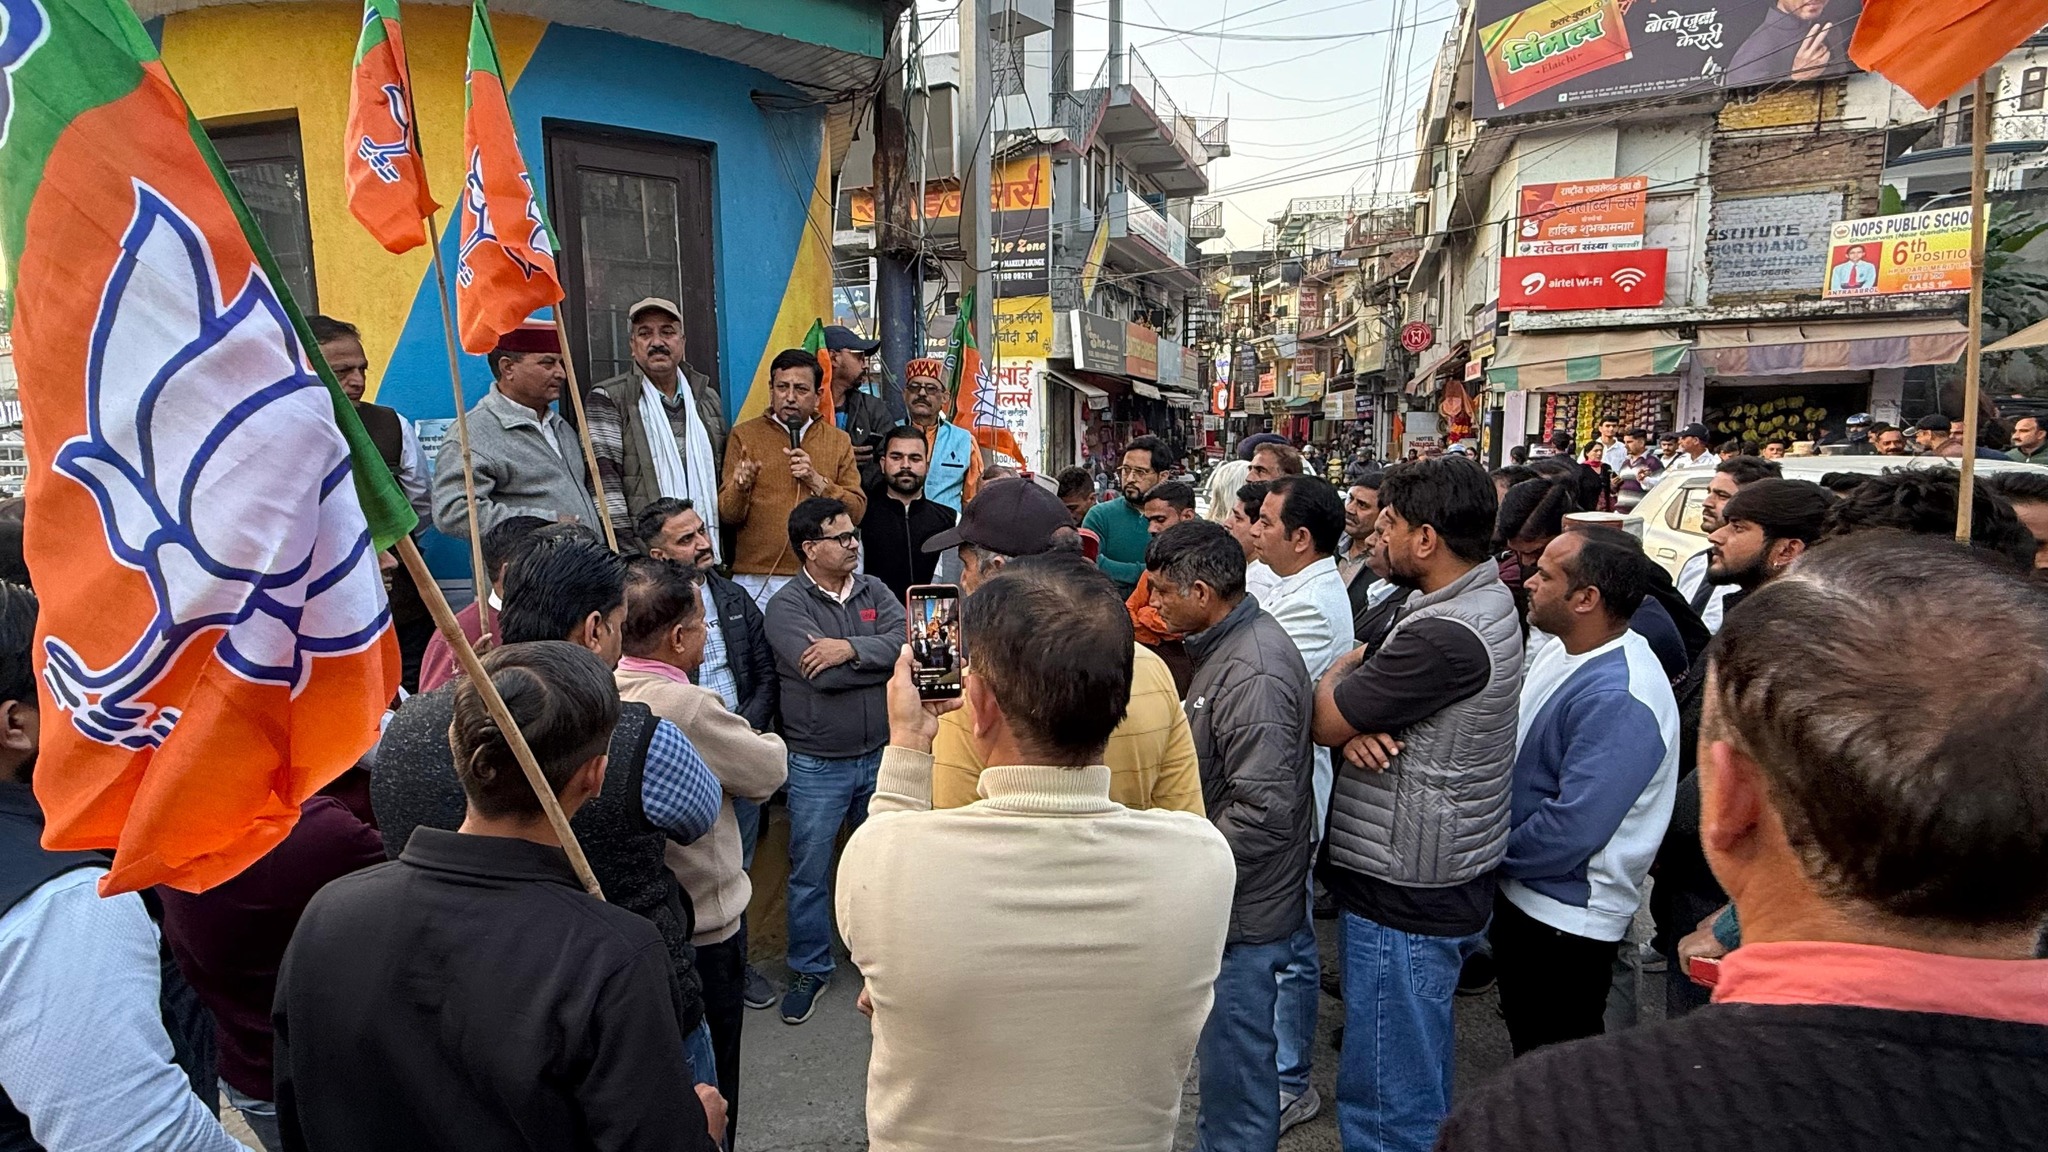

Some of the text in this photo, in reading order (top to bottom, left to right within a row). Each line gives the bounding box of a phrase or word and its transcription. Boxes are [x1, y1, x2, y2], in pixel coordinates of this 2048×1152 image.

[1645, 11, 1682, 33] बोलो
[1676, 23, 1724, 50] केसरी
[1541, 55, 1577, 75] Elaichi
[1548, 222, 1577, 237] हार्दिक
[1580, 218, 1635, 236] शुभकामनाएं
[1851, 220, 1883, 238] NOPS
[1886, 215, 1931, 233] PUBLIC
[1895, 231, 1918, 240] (Near
[1919, 228, 1949, 236] Gandhi
[1017, 239, 1047, 254] Zone
[1533, 241, 1580, 254] संवेदना
[1582, 241, 1608, 251] संस्था
[1893, 238, 1928, 266] 6th
[1003, 260, 1025, 268] MAKEUP
[1025, 258, 1045, 267] LOUNGE
[1913, 248, 1971, 263] POSITIO
[1549, 277, 1603, 289] airtel Wi-Fi
[1902, 282, 1935, 291] CLASS
[1026, 329, 1039, 344] फ्री
[1409, 441, 1435, 449] Nayan
